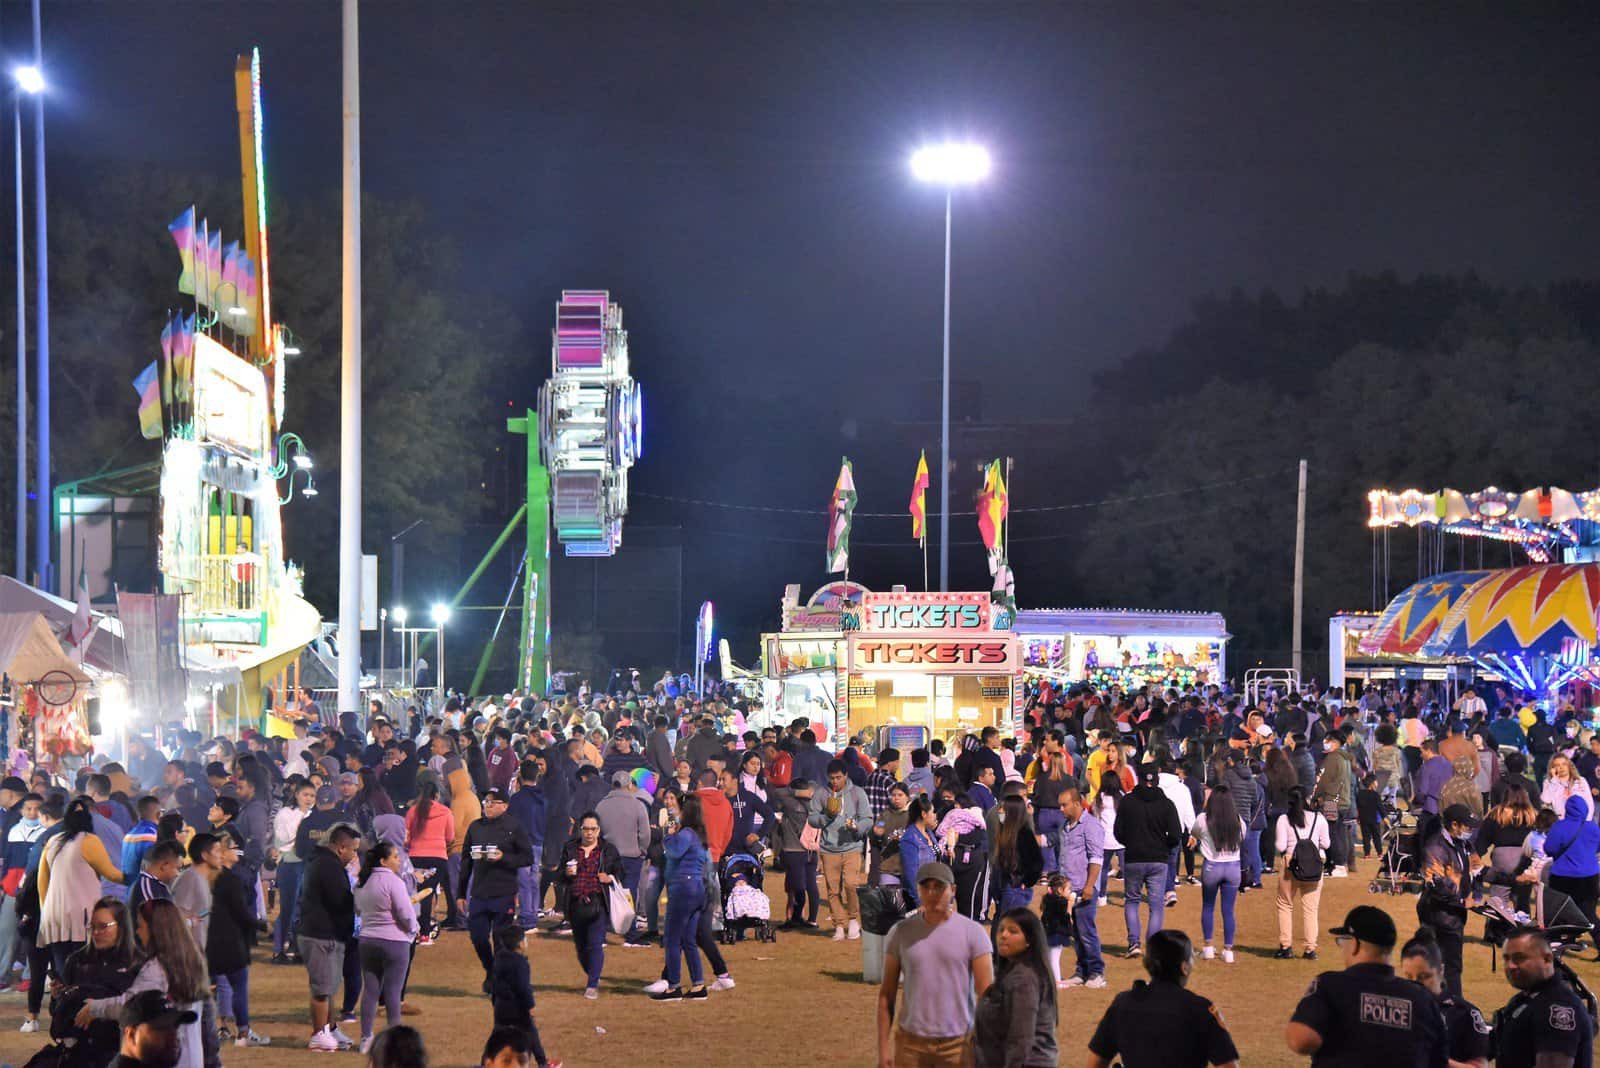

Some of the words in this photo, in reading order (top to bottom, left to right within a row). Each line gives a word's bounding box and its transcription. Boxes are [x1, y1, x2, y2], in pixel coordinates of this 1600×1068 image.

[872, 604, 981, 629] TICKETS
[993, 612, 1011, 631] AT
[858, 643, 1007, 663] TICKETS
[1364, 1004, 1408, 1025] POLICE
